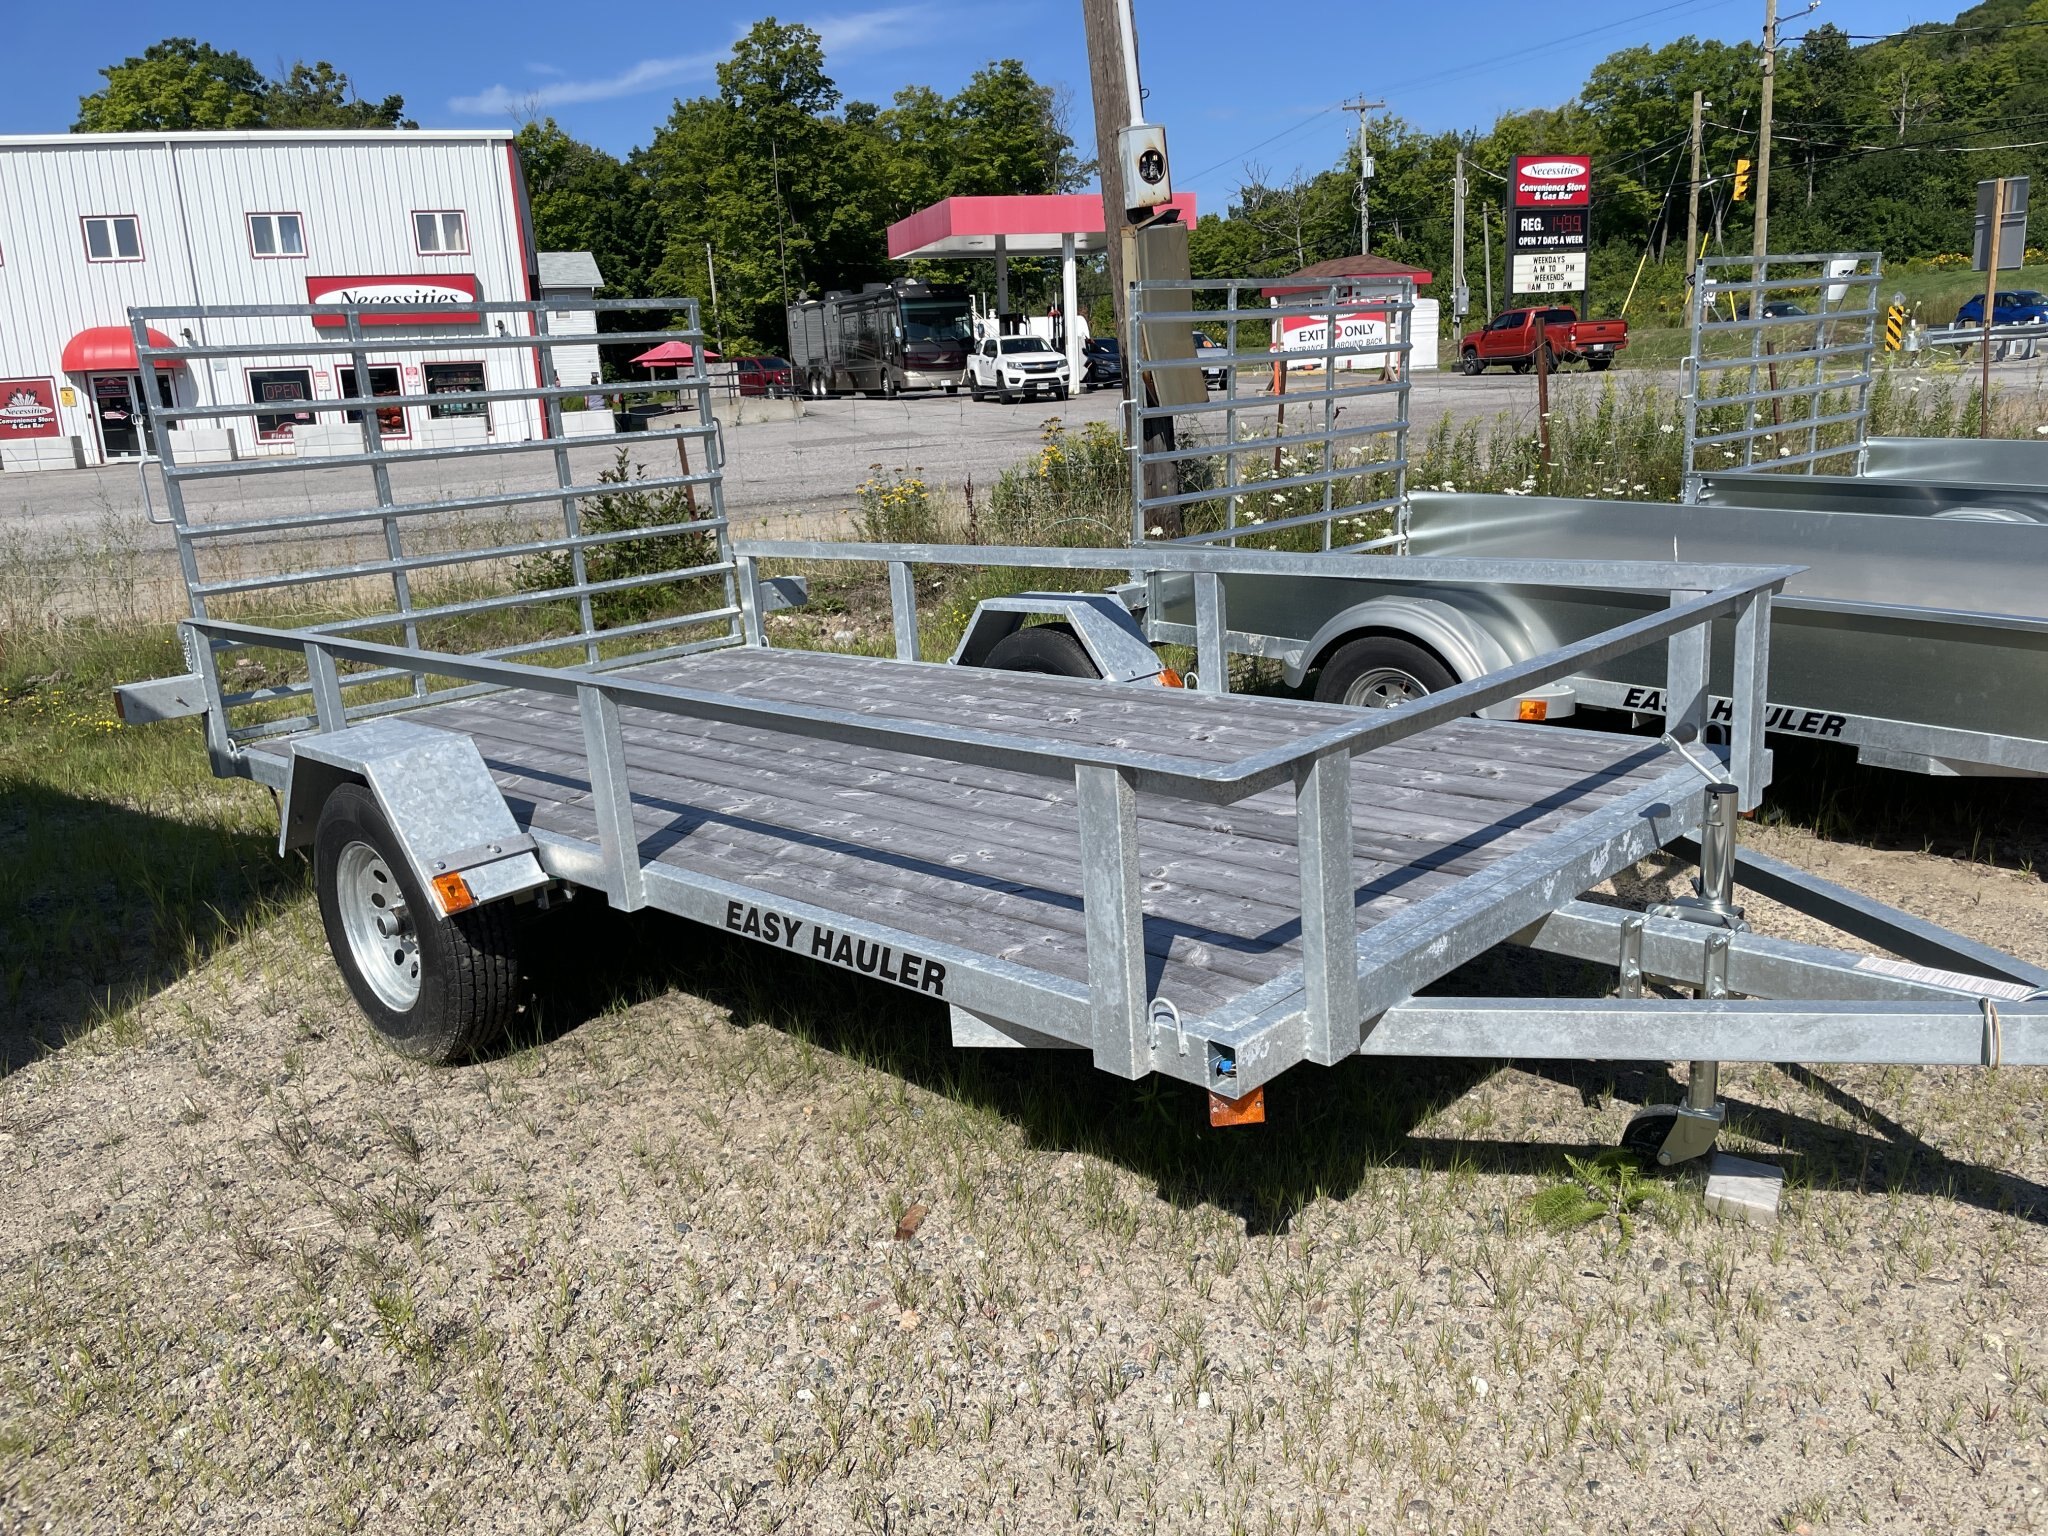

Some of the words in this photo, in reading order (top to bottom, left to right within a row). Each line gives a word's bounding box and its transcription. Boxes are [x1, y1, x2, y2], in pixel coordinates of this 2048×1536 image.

[1530, 165, 1580, 176] Necessities
[1519, 183, 1565, 192] Convenience
[1566, 182, 1586, 191] Store
[1534, 192, 1541, 201] &
[1542, 191, 1557, 200] Gas
[1558, 191, 1573, 200] Bar
[1520, 217, 1545, 232] REG.
[1518, 236, 1537, 246] OPEN
[1537, 236, 1541, 245] 7
[1542, 235, 1559, 245] DAYS
[1559, 235, 1565, 244] A
[1565, 234, 1584, 244] WEEK
[1533, 255, 1566, 265] WEEKDAYS
[1565, 264, 1575, 272] PM
[1534, 273, 1565, 282] WEEKENDS
[1547, 282, 1555, 290] TO
[1562, 281, 1573, 290] PM
[1299, 328, 1326, 342] EXIT
[1344, 323, 1375, 337] ONLY
[1366, 337, 1383, 346] BACK
[265, 384, 301, 400] OPEN
[4, 407, 48, 415] Necessities
[726, 900, 803, 947] EASY
[811, 925, 946, 996] HAULER
